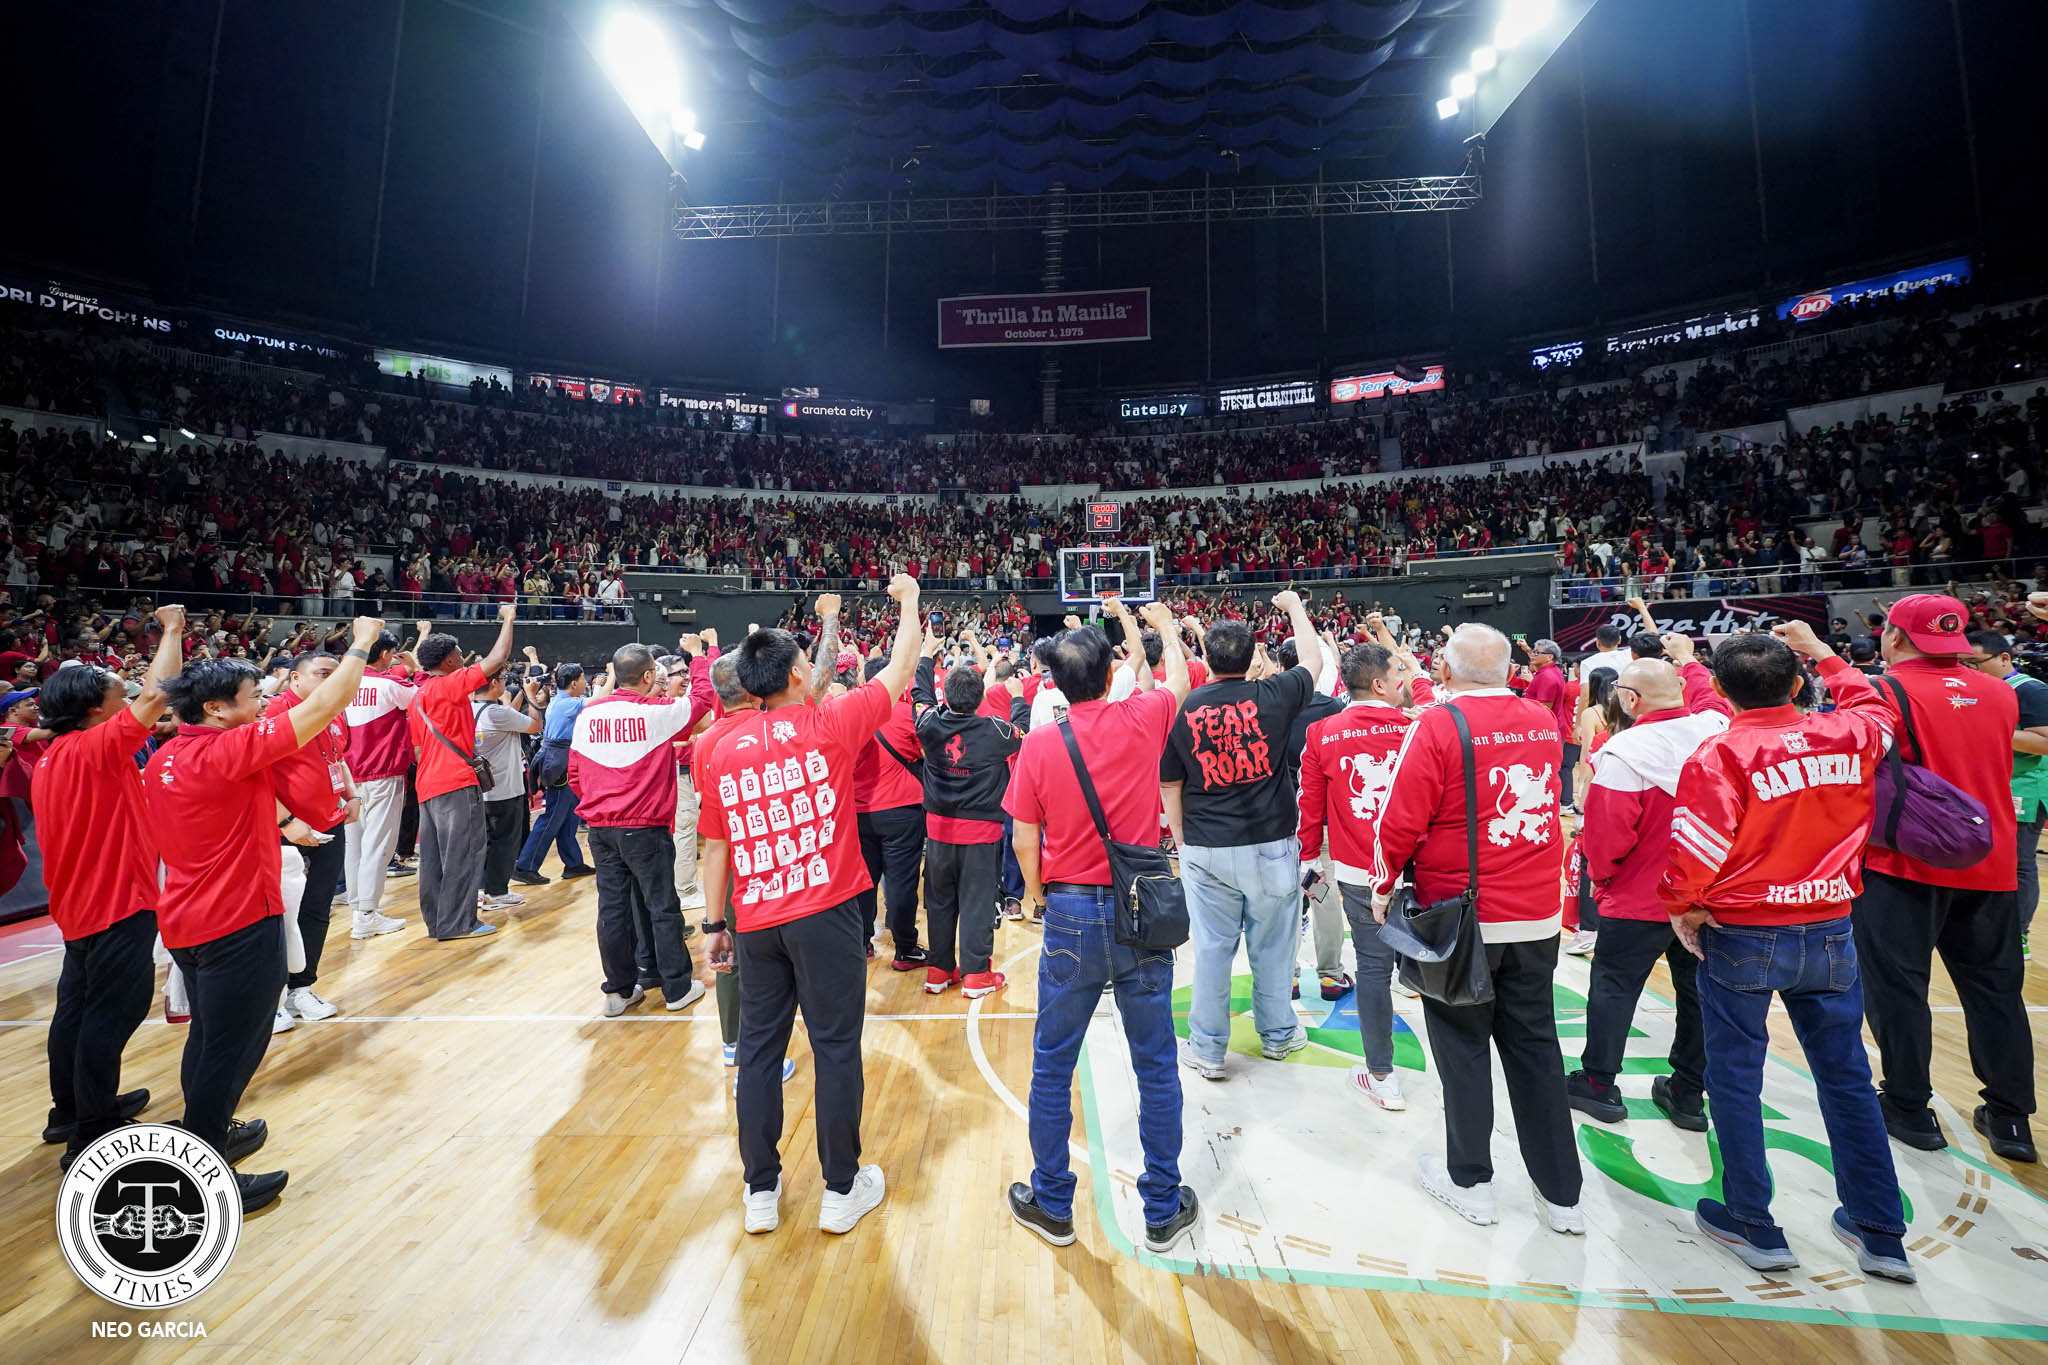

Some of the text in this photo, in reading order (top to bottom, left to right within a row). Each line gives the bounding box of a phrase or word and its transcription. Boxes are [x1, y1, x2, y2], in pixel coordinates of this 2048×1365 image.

[956, 302, 1133, 326] "Thrilla In Manila"
[1798, 299, 1827, 317] DQ
[1004, 329, 1048, 339] October
[1059, 327, 1084, 338] 1975
[1685, 312, 1760, 340] Market
[1360, 378, 1405, 395] Tender
[1257, 387, 1316, 408] CARNIVAL
[802, 405, 847, 416] araneta
[849, 406, 873, 420] city
[1096, 515, 1110, 527] 24
[590, 717, 647, 743] SAN BEDA
[1184, 700, 1269, 756] FEAR
[1321, 733, 1340, 746] San
[1342, 728, 1368, 741] Beda
[1472, 735, 1489, 746] an
[1492, 730, 1525, 746] Beda
[1212, 732, 1244, 753] THE
[1195, 740, 1273, 791] ROAR
[722, 760, 822, 799] 21 8 13 33 2
[1751, 754, 1862, 802] SAN BEDA
[750, 814, 764, 829] 15
[772, 809, 787, 823] 12
[795, 801, 809, 816] 10
[822, 793, 830, 806] 4
[758, 849, 769, 863] 11
[783, 844, 790, 857] 1
[813, 864, 822, 877] C
[1765, 872, 1857, 904] HERRERA
